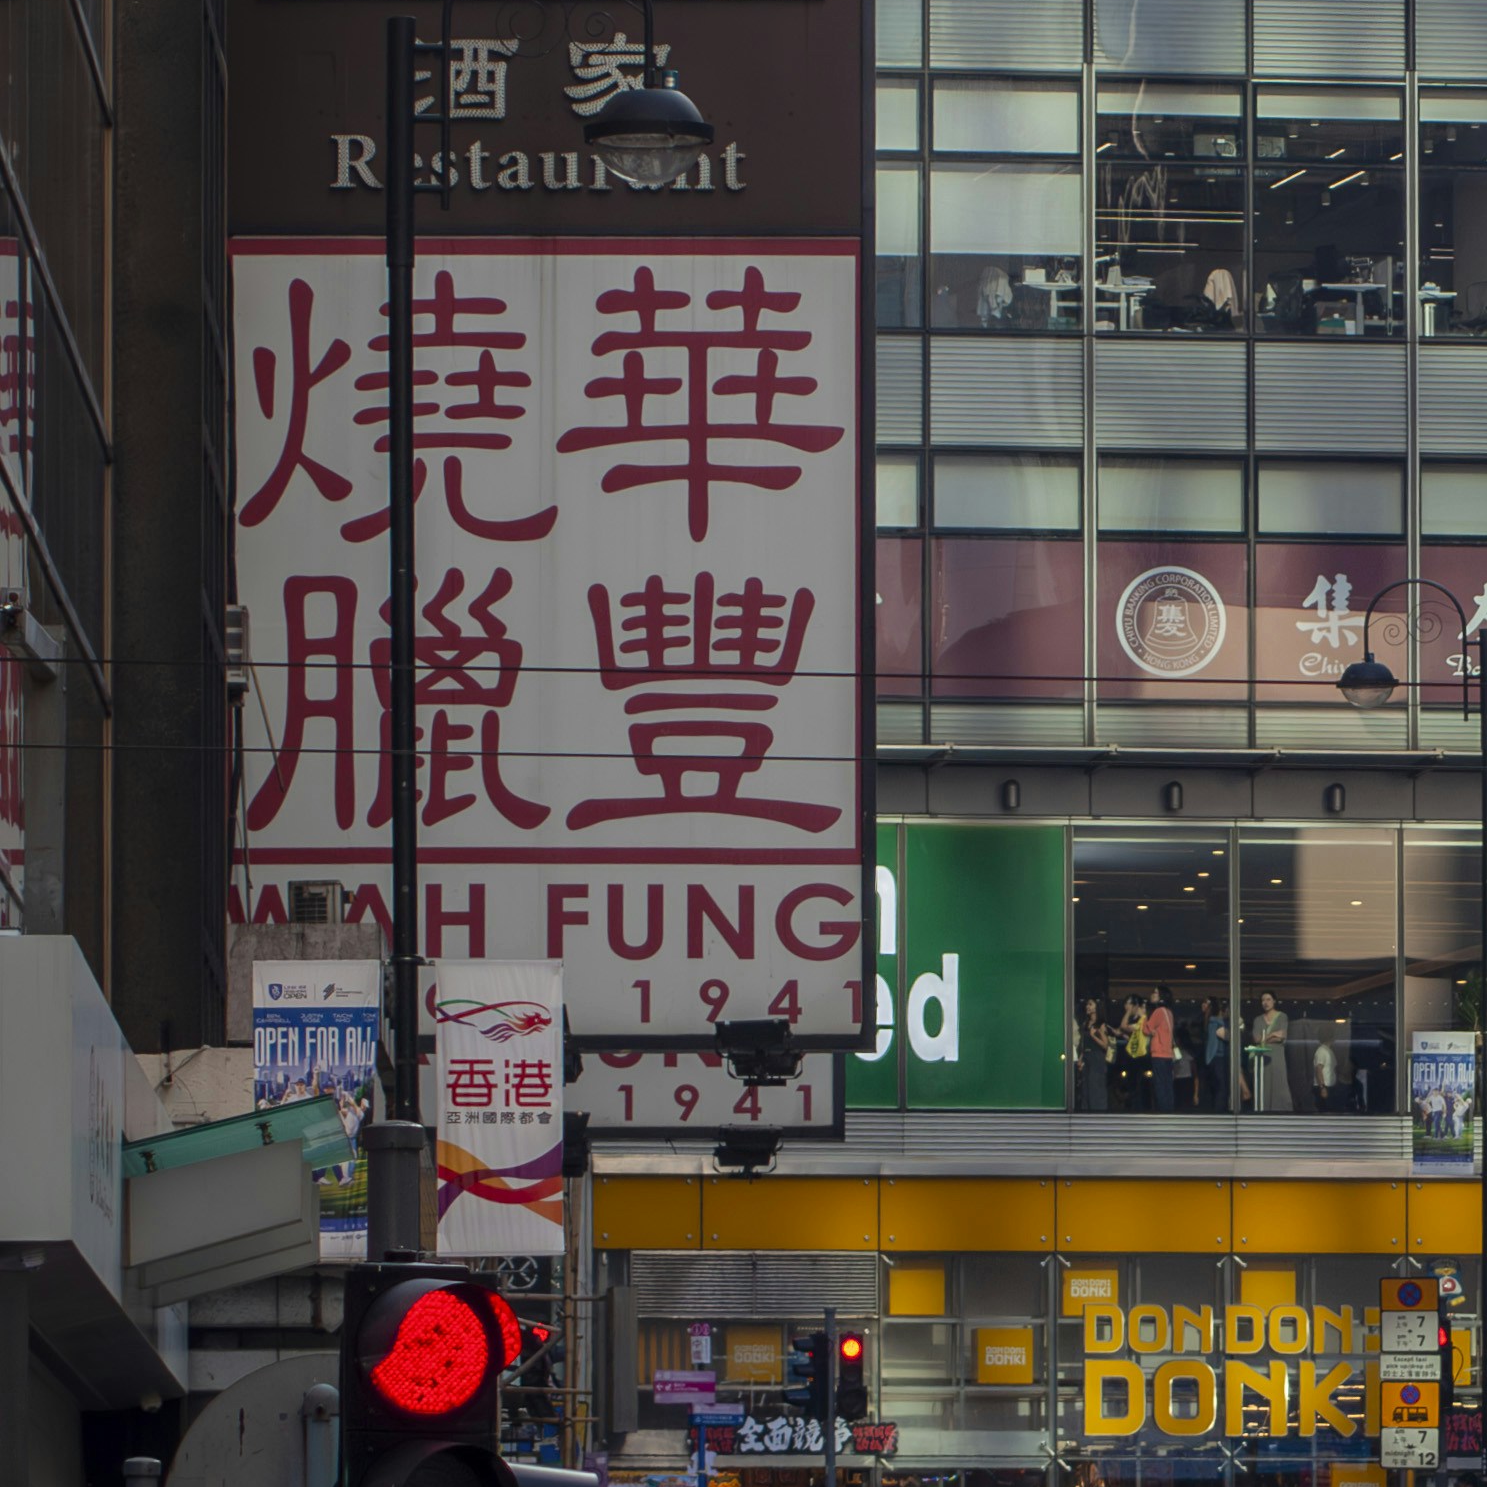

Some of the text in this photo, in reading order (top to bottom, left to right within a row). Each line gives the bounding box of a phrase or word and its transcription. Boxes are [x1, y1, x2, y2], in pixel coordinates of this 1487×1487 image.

[415, 33, 671, 121] 酒家
[330, 134, 747, 192] Rstaurnt
[556, 265, 845, 834] 華豐
[1123, 573, 1219, 649] CHIYU BANKING CORPORATION LIMITED
[1142, 651, 1199, 670] HONG KONG
[547, 882, 862, 961] FUNG
[633, 980, 863, 1023] 1941
[254, 1026, 377, 1073] OPEN FOR ALL
[446, 1059, 553, 1109] 香港
[1413, 1062, 1436, 1083] OPEN
[1437, 1062, 1455, 1084] FOR
[446, 1111, 553, 1125] 亞洲國際都會
[618, 1084, 813, 1122] 1941
[1071, 1286, 1111, 1298] DONKI
[1084, 1304, 1213, 1353] DON
[1416, 1316, 1425, 1328] 7
[1416, 1335, 1425, 1347] 7
[1084, 1360, 1380, 1438] DONKI
[1418, 1430, 1427, 1443] 7
[1418, 1452, 1436, 1466] 12
